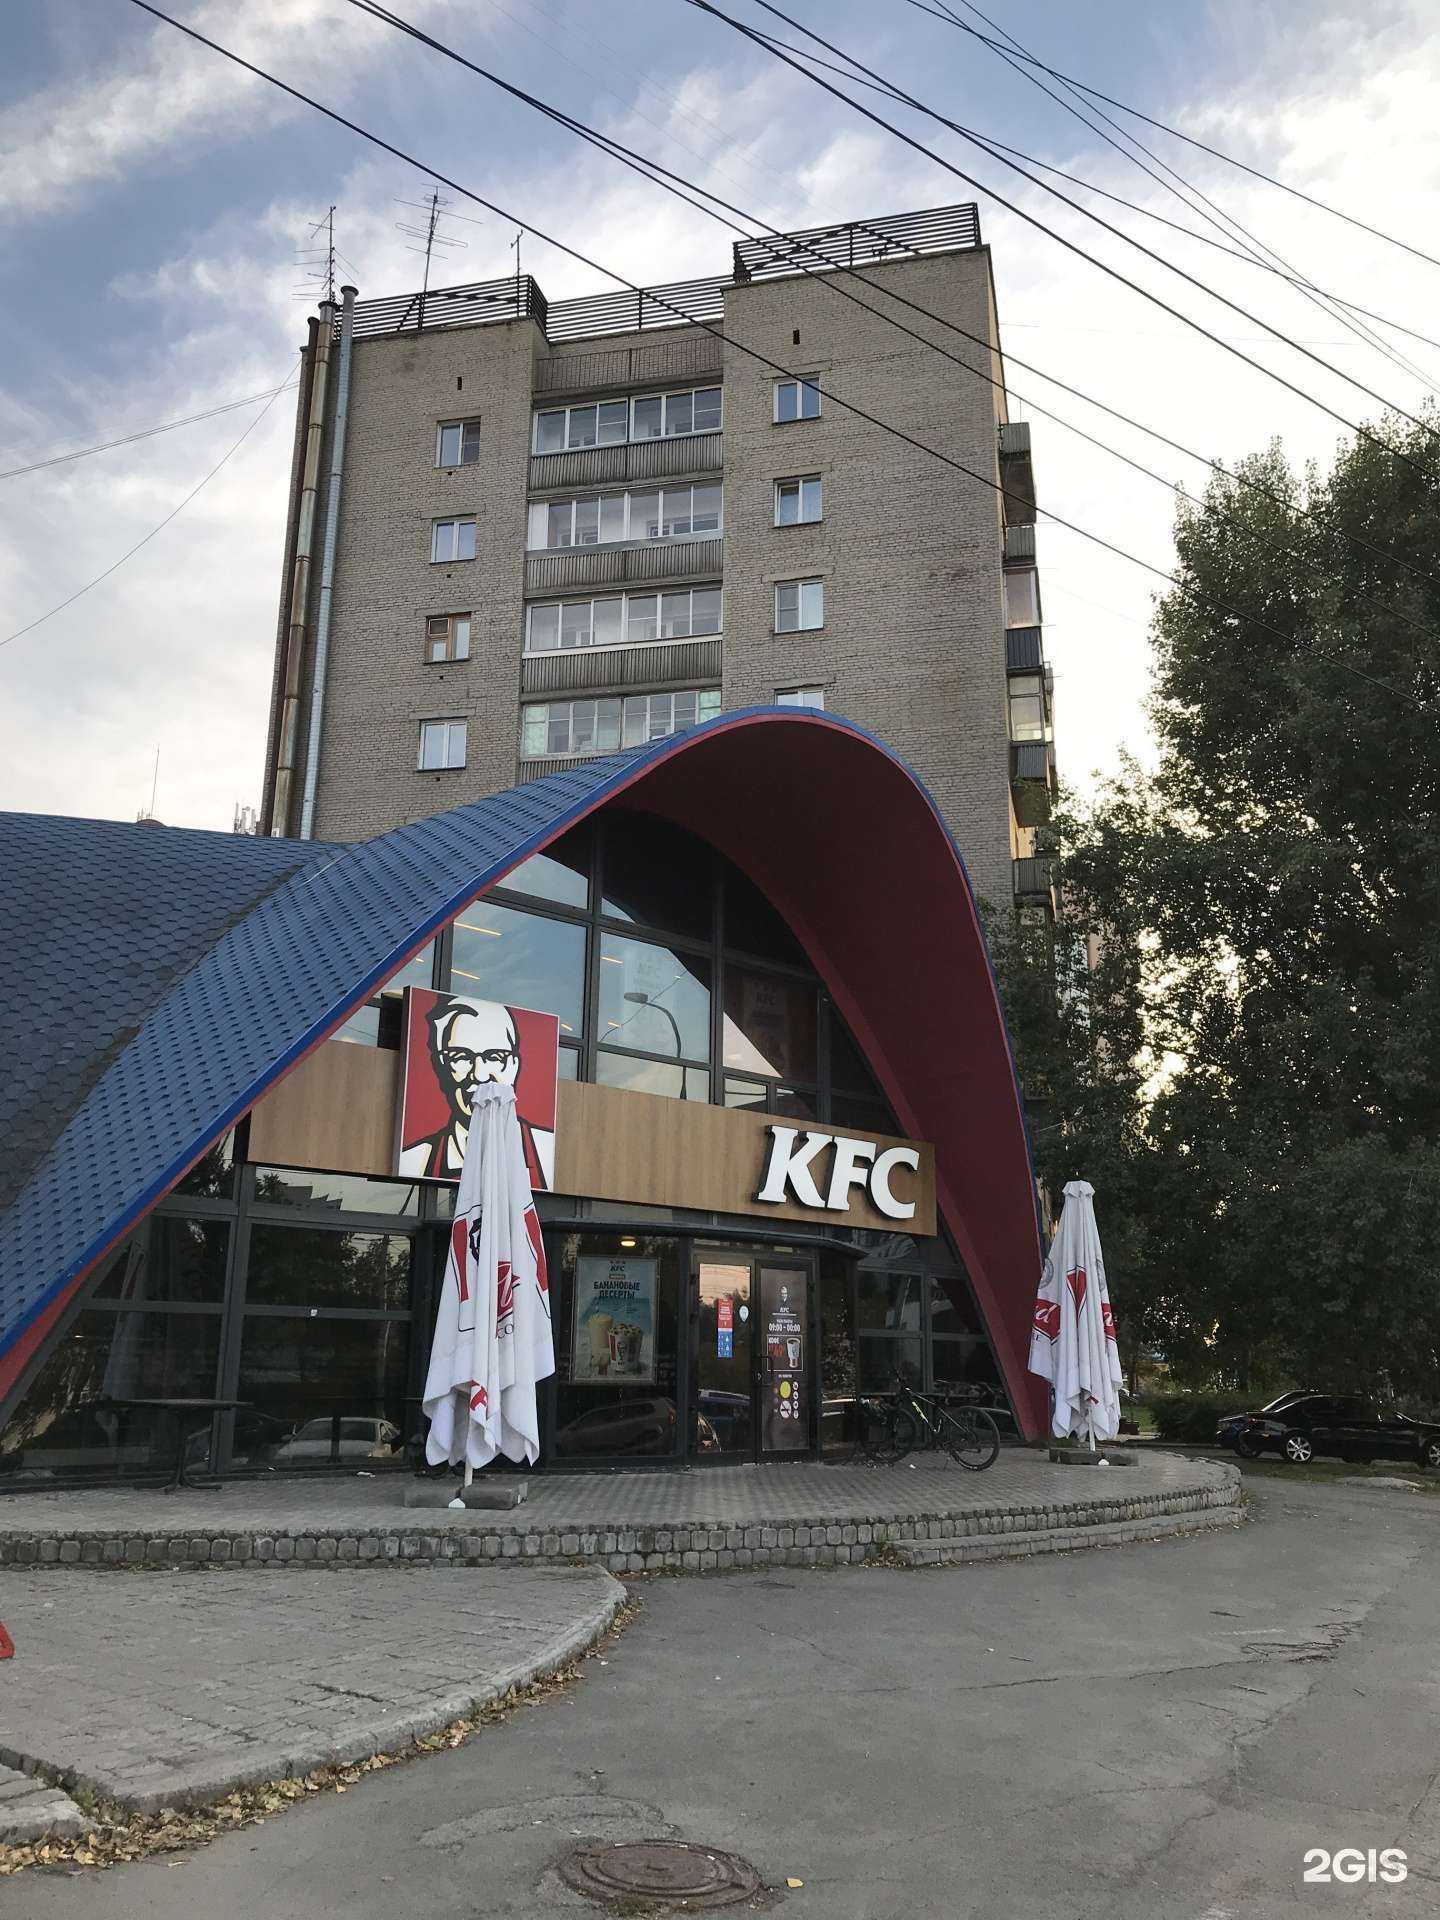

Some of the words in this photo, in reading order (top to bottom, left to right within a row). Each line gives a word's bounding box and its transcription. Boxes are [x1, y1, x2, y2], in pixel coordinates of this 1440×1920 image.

[758, 1124, 919, 1219] KFC
[593, 1281, 641, 1291] БАНАНОВЫЕ
[598, 1290, 635, 1300] ДЕСЕРТЫ
